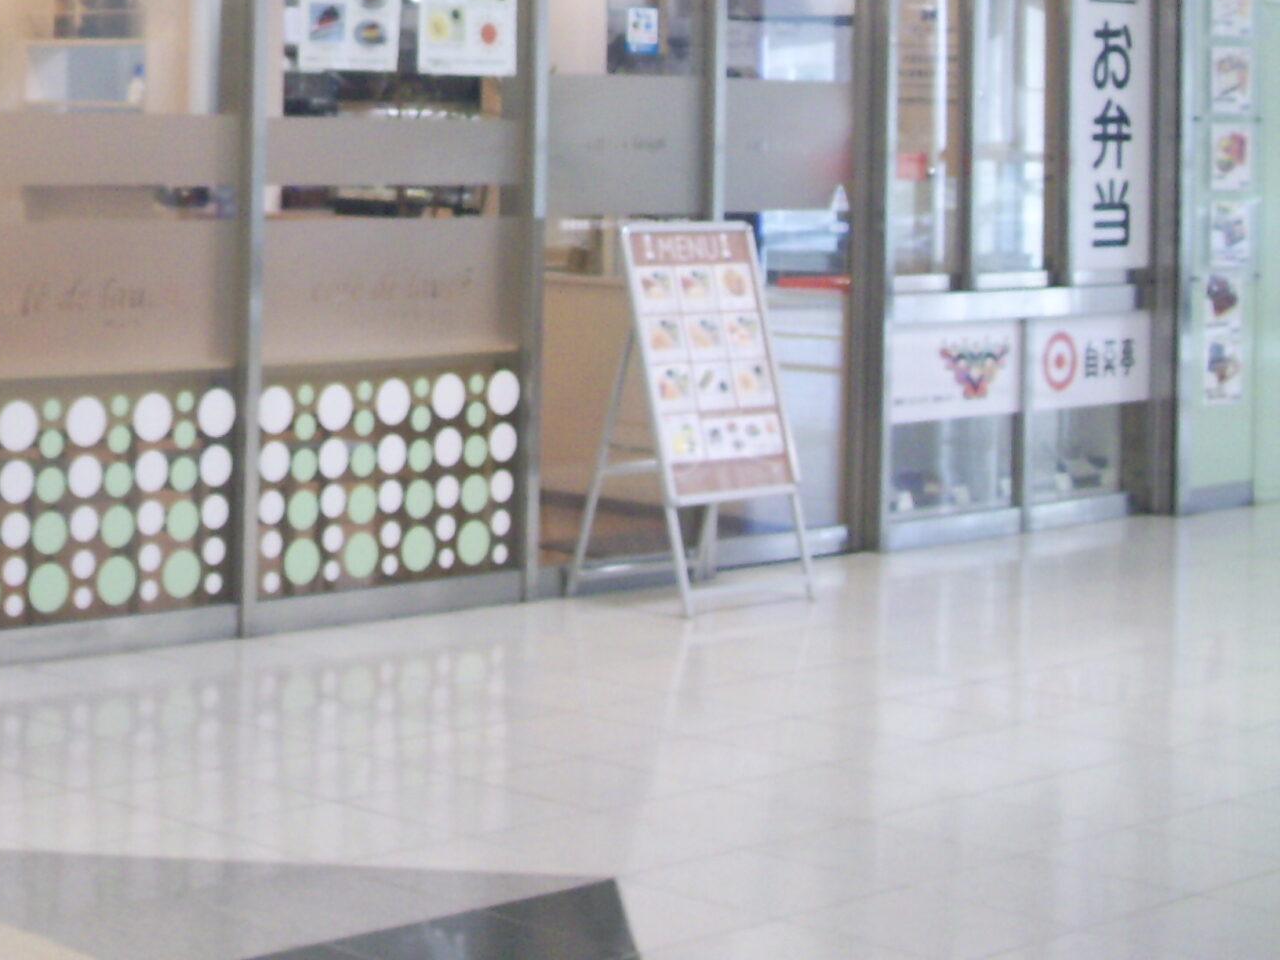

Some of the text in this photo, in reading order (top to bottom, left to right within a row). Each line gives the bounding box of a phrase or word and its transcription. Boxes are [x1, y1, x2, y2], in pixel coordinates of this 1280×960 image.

[1091, 20, 1133, 248] お弁当
[658, 234, 719, 262] MENU
